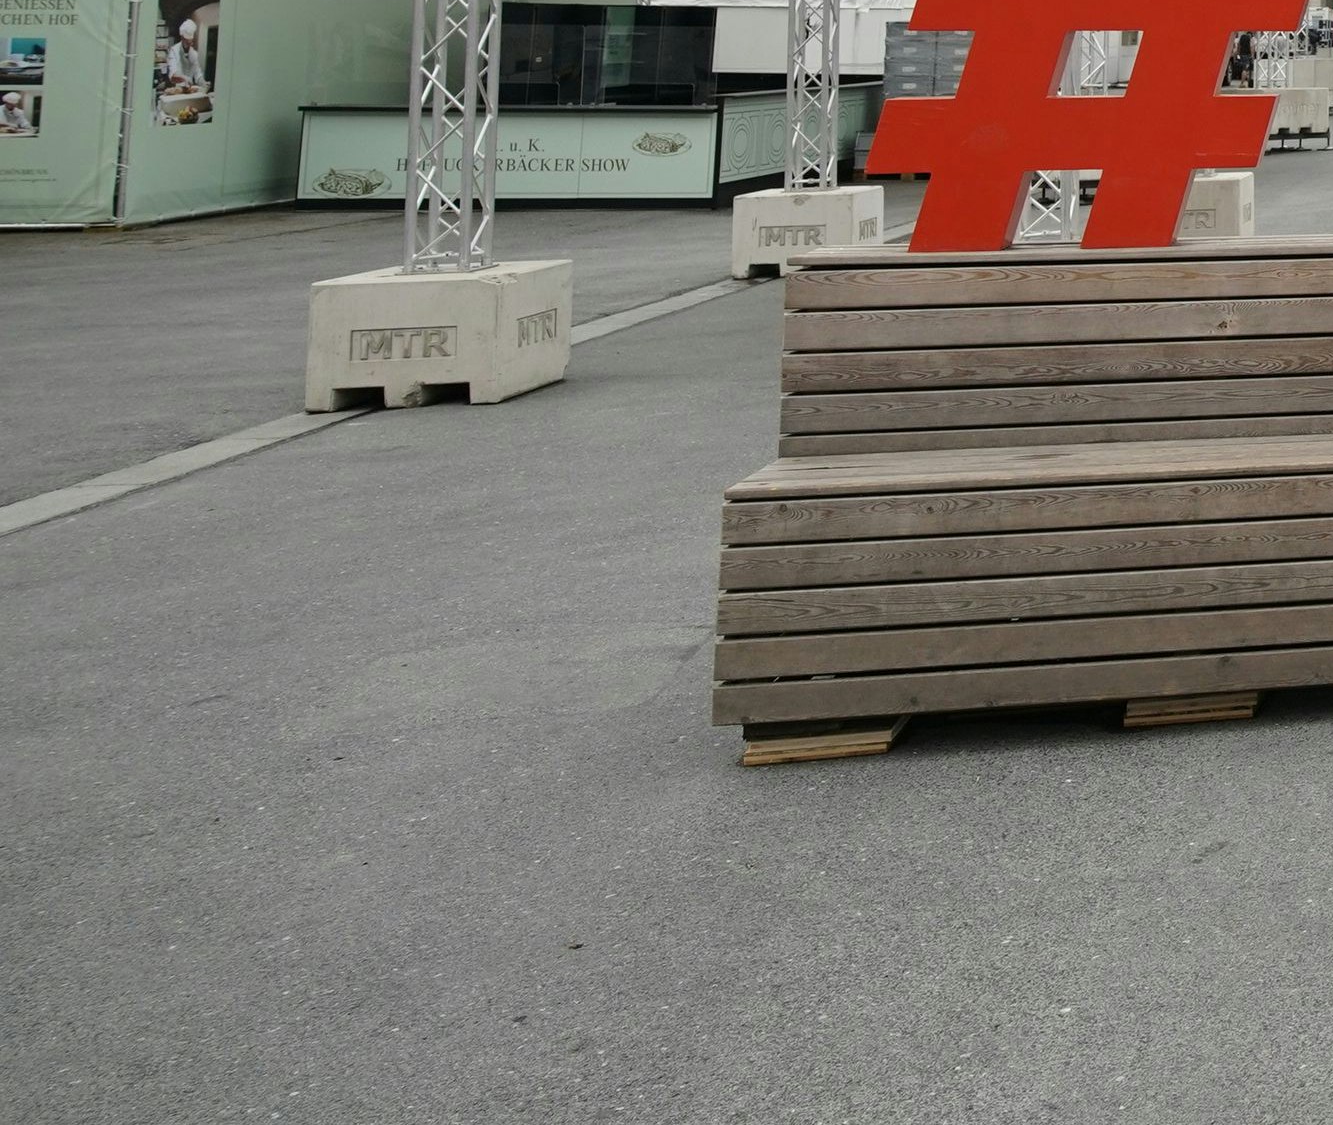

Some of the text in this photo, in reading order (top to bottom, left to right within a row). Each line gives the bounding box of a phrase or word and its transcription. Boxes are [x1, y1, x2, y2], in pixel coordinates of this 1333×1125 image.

[48, 14, 79, 26] HOF
[509, 138, 545, 152] u. K.
[581, 157, 630, 172] SHOW
[764, 227, 823, 246] MTR
[517, 314, 554, 348] MTR
[359, 330, 452, 360] MTR
